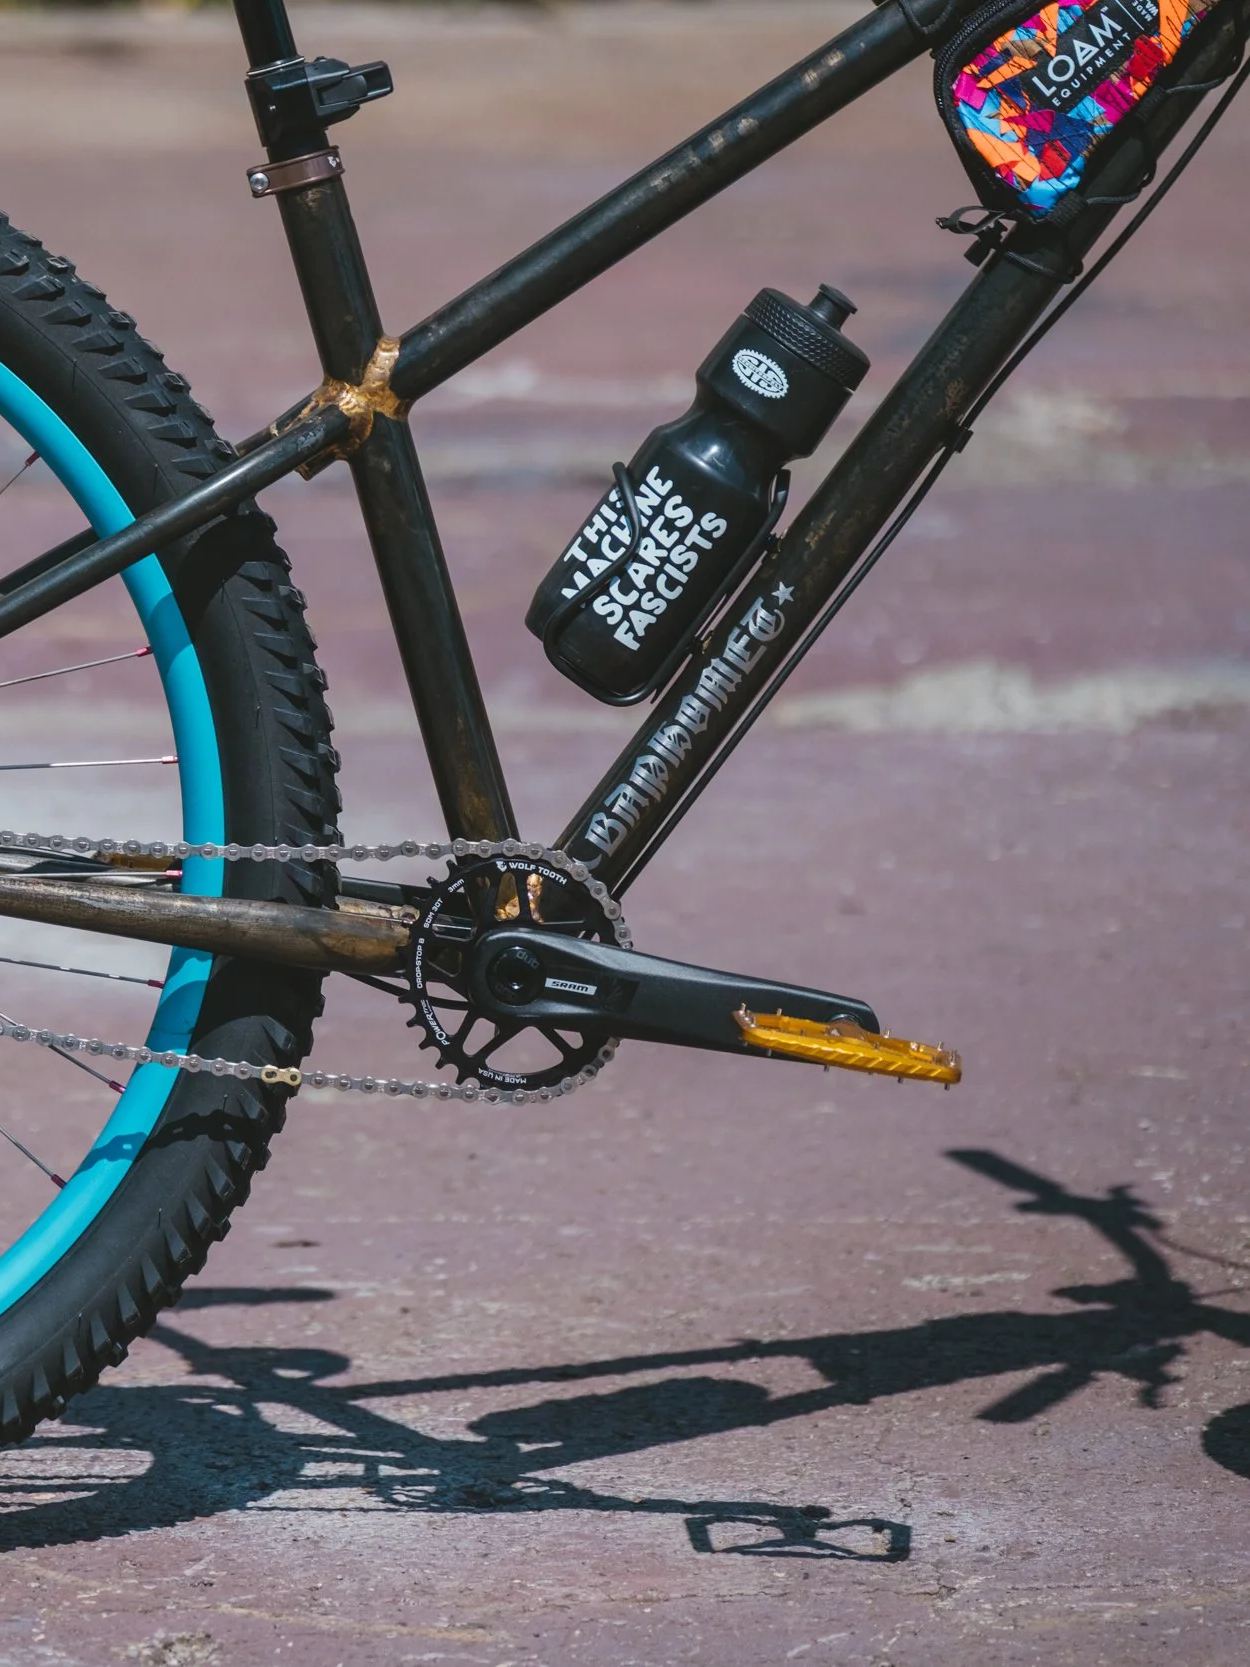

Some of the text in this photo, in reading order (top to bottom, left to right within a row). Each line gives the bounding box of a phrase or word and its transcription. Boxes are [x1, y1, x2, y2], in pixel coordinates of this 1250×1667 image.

[1031, 12, 1123, 97] LOAM
[1051, 31, 1132, 107] EQUIPMENT
[561, 465, 674, 609] MACHNE
[592, 495, 694, 625] SCARES
[613, 512, 728, 651] FASCISTS
[508, 862, 568, 885] WOLF TOOTH
[447, 878, 465, 893] 3mm
[432, 897, 444, 912] 30T
[415, 944, 424, 990] DROP-STOP
[551, 980, 589, 993] SRAM
[478, 1067, 495, 1079] USA
[494, 1074, 504, 1082] IN
[504, 1076, 527, 1084] MADE
